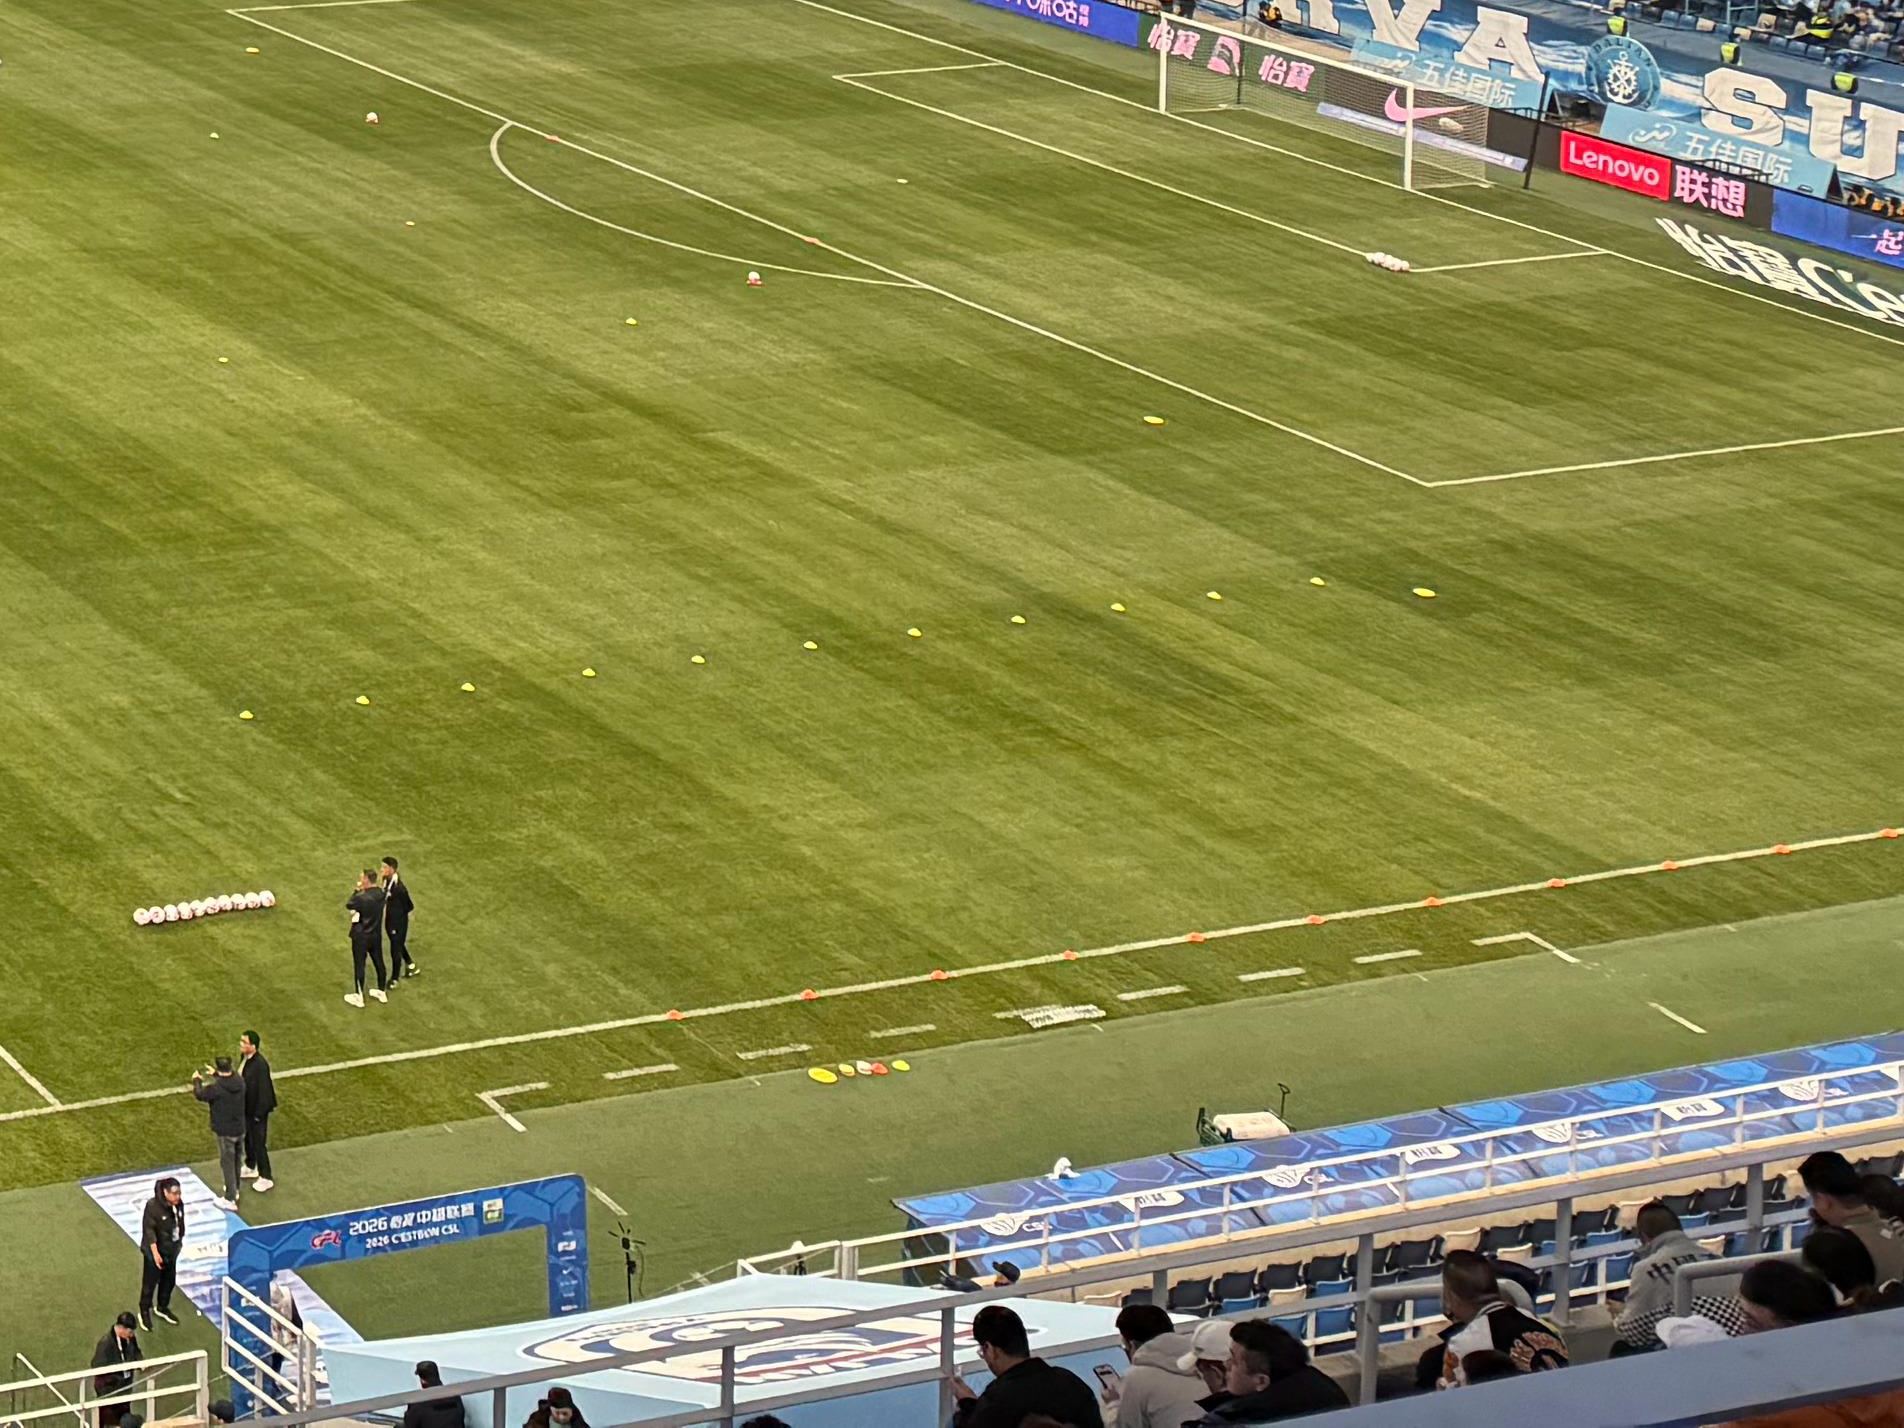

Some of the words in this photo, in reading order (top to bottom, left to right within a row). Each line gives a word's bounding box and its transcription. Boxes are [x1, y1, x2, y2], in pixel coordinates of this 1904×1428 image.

[1421, 59, 1518, 108] 五佳国际
[1569, 140, 1661, 187] Lenovo
[1679, 130, 1793, 184] 五佳国际
[1674, 164, 1746, 219] 联想
[348, 1216, 388, 1236] 2026
[365, 1234, 390, 1249] 2026
[441, 1223, 460, 1236] CSL
